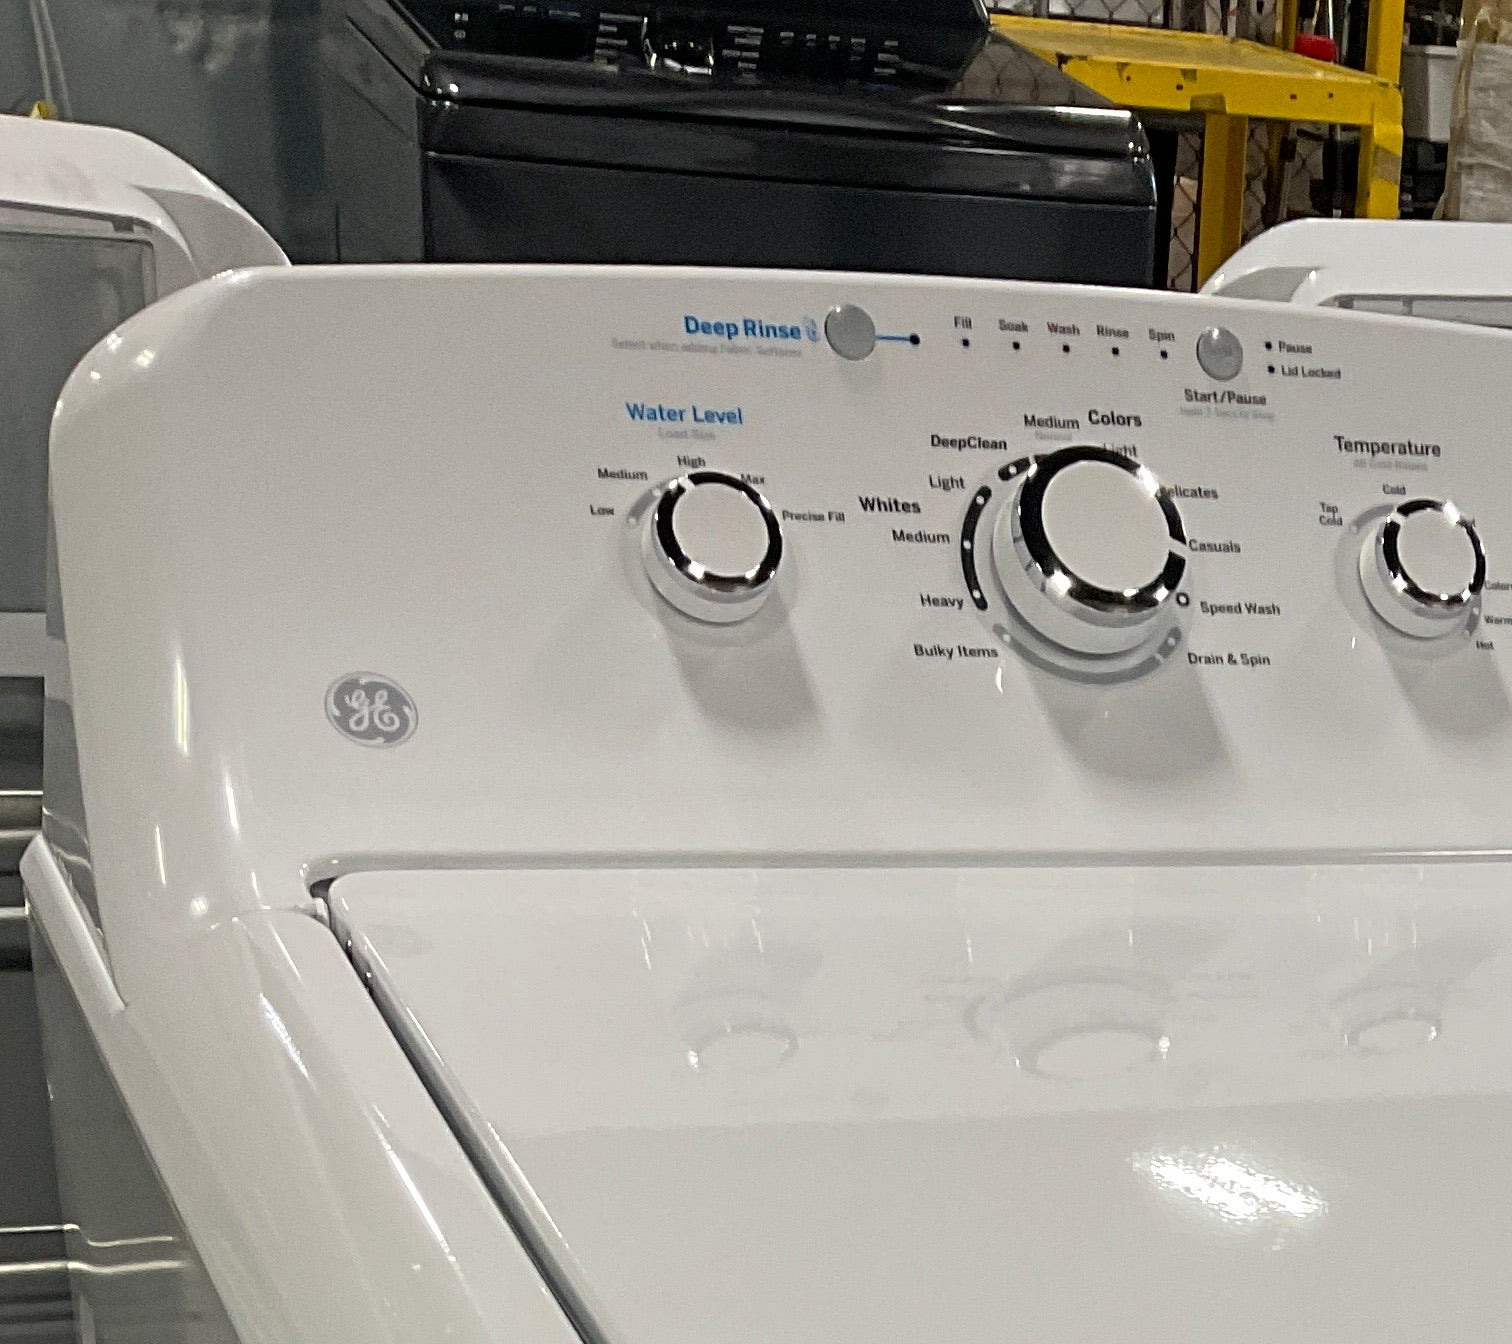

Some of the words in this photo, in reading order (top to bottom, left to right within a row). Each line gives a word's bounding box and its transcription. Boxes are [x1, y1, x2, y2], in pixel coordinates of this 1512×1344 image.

[683, 314, 740, 341] Deep
[743, 316, 802, 340] Rinse
[953, 315, 973, 330] Fill
[998, 318, 1029, 333] Soak
[1047, 320, 1081, 336] Wash
[1096, 324, 1130, 340] Rinse
[1148, 327, 1176, 343] Spin
[1278, 340, 1313, 355] Pause
[1281, 364, 1299, 377] Lid
[1301, 365, 1341, 380] Locked
[1184, 388, 1268, 406] Start/Pause
[625, 401, 686, 423] Water
[691, 404, 744, 425] Level
[1087, 409, 1143, 428] Colors
[1023, 413, 1080, 430] Medium
[930, 433, 1008, 451] DeepClean
[1333, 434, 1442, 458] Temperature
[676, 454, 706, 469] High
[597, 467, 648, 482] Medium
[928, 474, 966, 492] Light
[1382, 483, 1407, 496] Cold
[1166, 484, 1219, 500] elicates
[589, 503, 615, 516] Low
[858, 495, 922, 515] Whites
[1319, 501, 1339, 517] Tap
[781, 508, 825, 523] Precise
[827, 510, 846, 522] Fill
[1318, 514, 1344, 526] Cold
[891, 528, 951, 545] Medium
[1188, 538, 1242, 554] Casuals
[919, 593, 965, 610] Heavy
[1200, 602, 1243, 617] Speed
[1245, 602, 1281, 617] Wash
[913, 643, 954, 660] Bulky
[957, 643, 999, 659] Items
[1187, 651, 1224, 666] Drain
[1227, 652, 1237, 666] &
[1240, 653, 1271, 668] Spin
